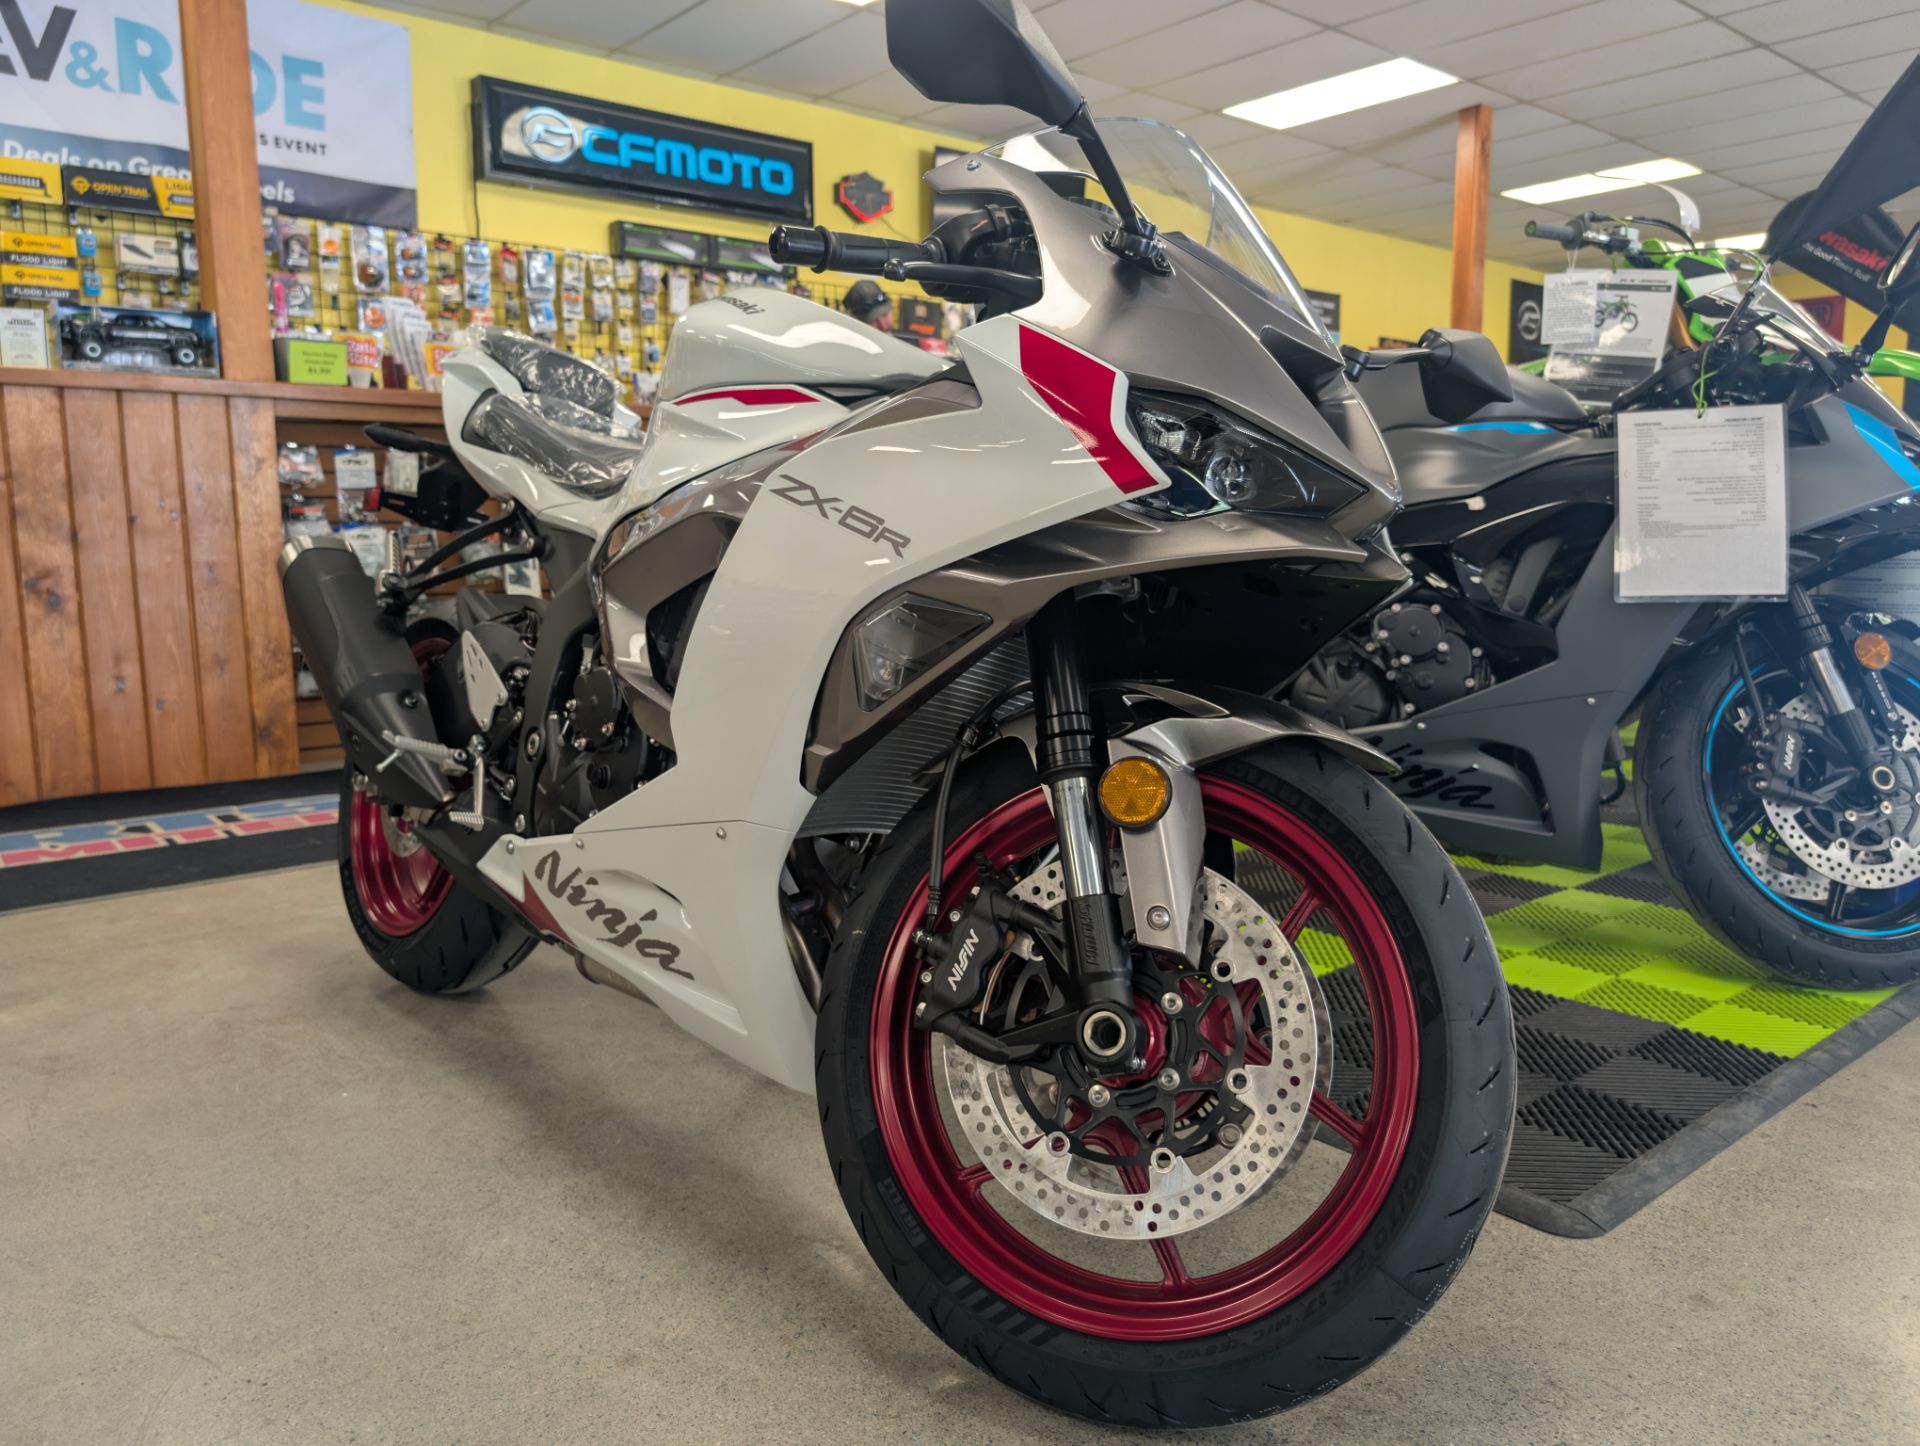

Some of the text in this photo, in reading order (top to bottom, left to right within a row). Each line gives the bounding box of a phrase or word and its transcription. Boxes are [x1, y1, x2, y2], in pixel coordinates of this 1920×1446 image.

[274, 136, 327, 156] EVENT
[128, 157, 191, 180] Grea
[582, 126, 793, 196] CFMOTO
[92, 182, 121, 193] OPEN
[10, 253, 68, 266] FLOOD LIGHT
[13, 287, 70, 298] FLOOD LIGHT
[768, 473, 912, 559] ZX-6R
[534, 849, 696, 981] Ninja
[947, 928, 980, 992] NISSIN
